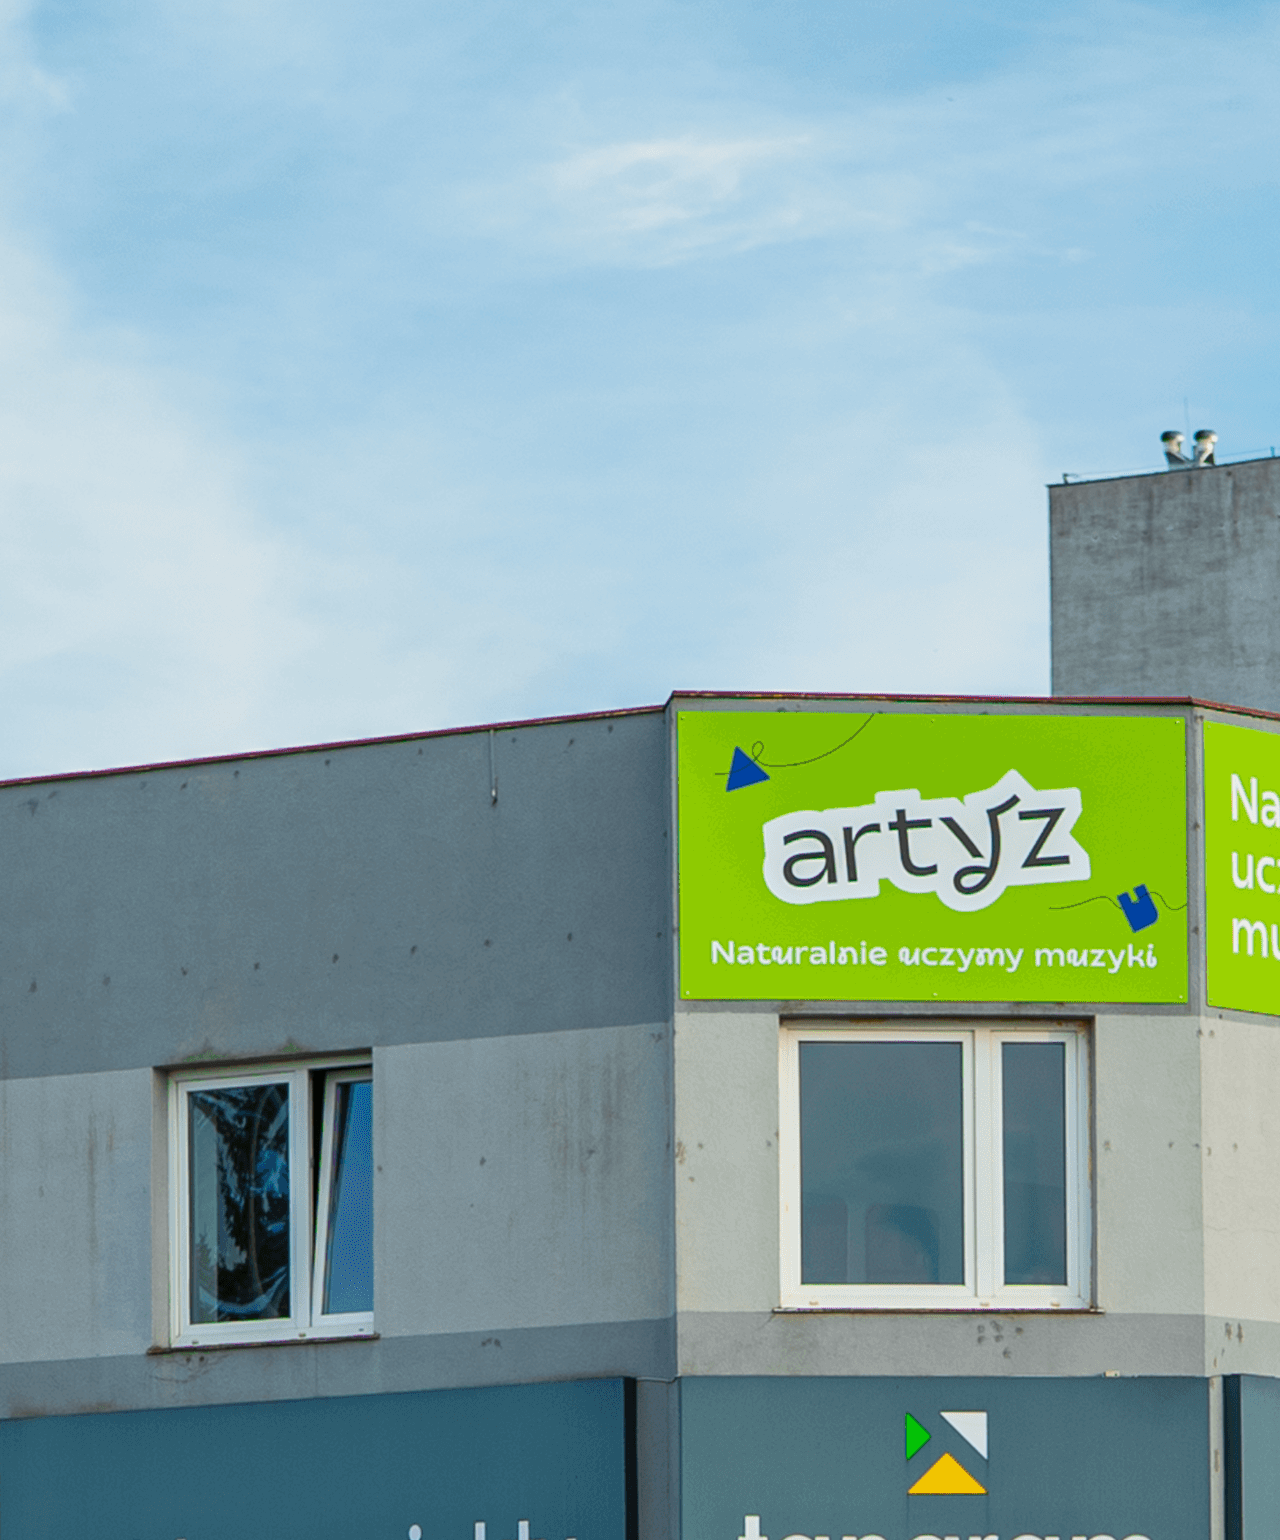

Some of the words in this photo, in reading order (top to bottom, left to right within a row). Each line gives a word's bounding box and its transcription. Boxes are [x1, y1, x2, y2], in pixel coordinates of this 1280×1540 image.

[783, 794, 1071, 895] artyz
[710, 940, 888, 966] Naturalnie
[898, 944, 1024, 972] uczymy
[1034, 943, 1158, 974] muzyki
